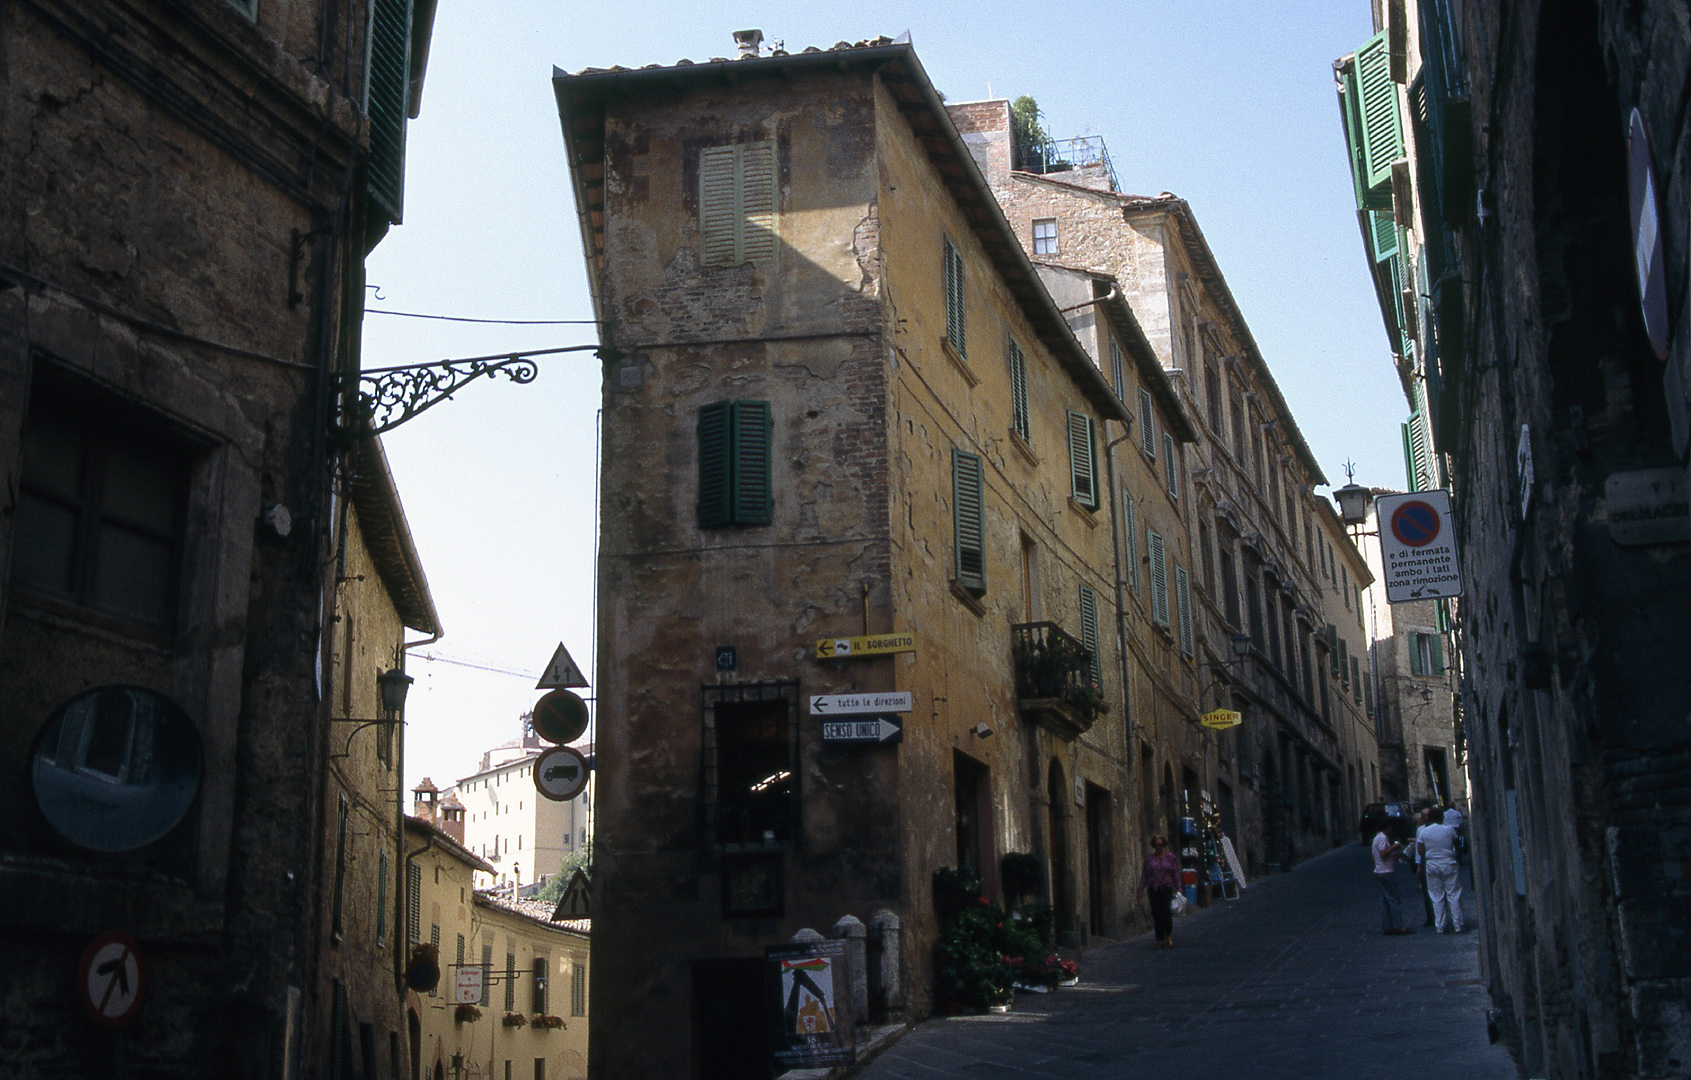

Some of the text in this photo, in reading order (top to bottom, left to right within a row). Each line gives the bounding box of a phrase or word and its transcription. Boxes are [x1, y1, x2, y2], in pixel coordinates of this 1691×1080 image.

[1389, 546, 1450, 560] e di fermata
[1391, 555, 1451, 570] permanente
[1395, 568, 1423, 578] ambo
[1433, 564, 1450, 574] lati
[1389, 574, 1459, 588] zona rimozione
[853, 637, 912, 651] IL BORGHETTO
[838, 697, 906, 708] tutte le direzioni
[1203, 713, 1238, 722] SINGER
[825, 723, 881, 738] SENSO UNICO
